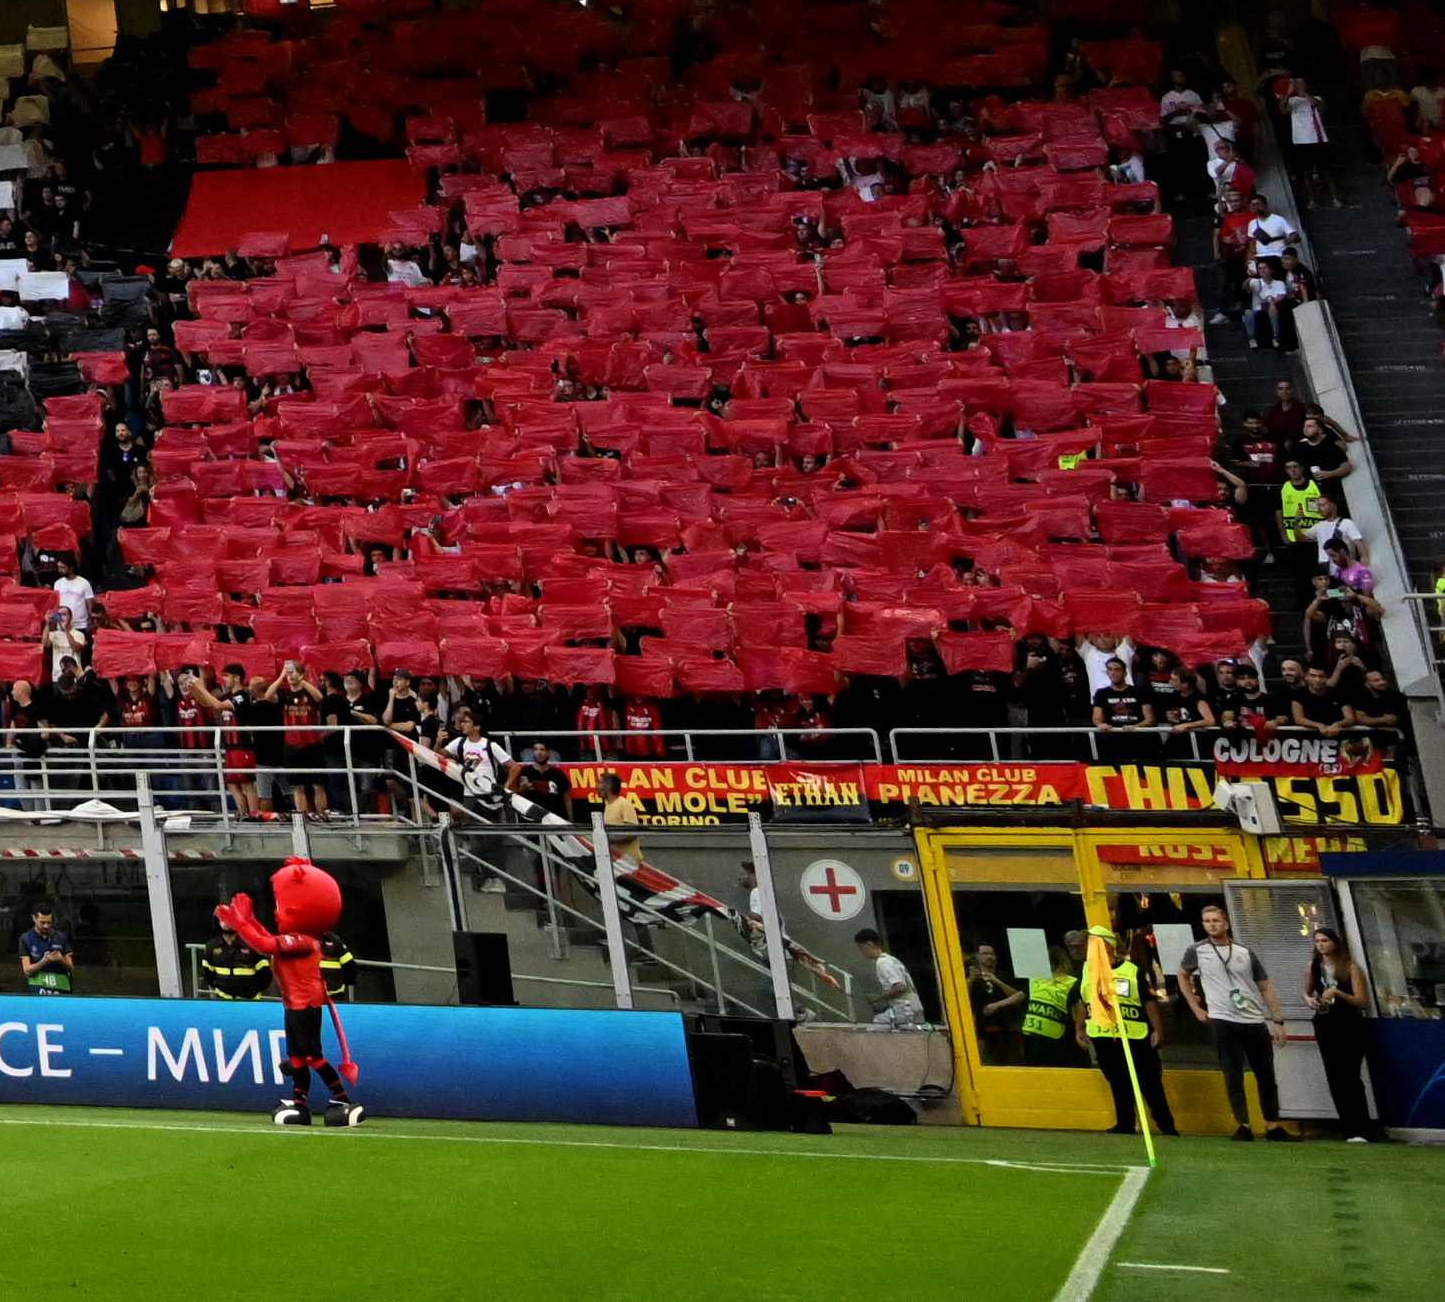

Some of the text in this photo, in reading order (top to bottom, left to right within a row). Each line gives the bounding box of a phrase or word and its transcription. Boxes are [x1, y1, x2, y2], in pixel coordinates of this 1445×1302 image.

[1214, 737, 1338, 763] COLOGNE
[897, 768, 1037, 783] MILAN CLUB
[776, 782, 861, 806] ETHAN
[879, 783, 1063, 805] PIANEZZA
[1086, 764, 1404, 825] CHIVSSO
